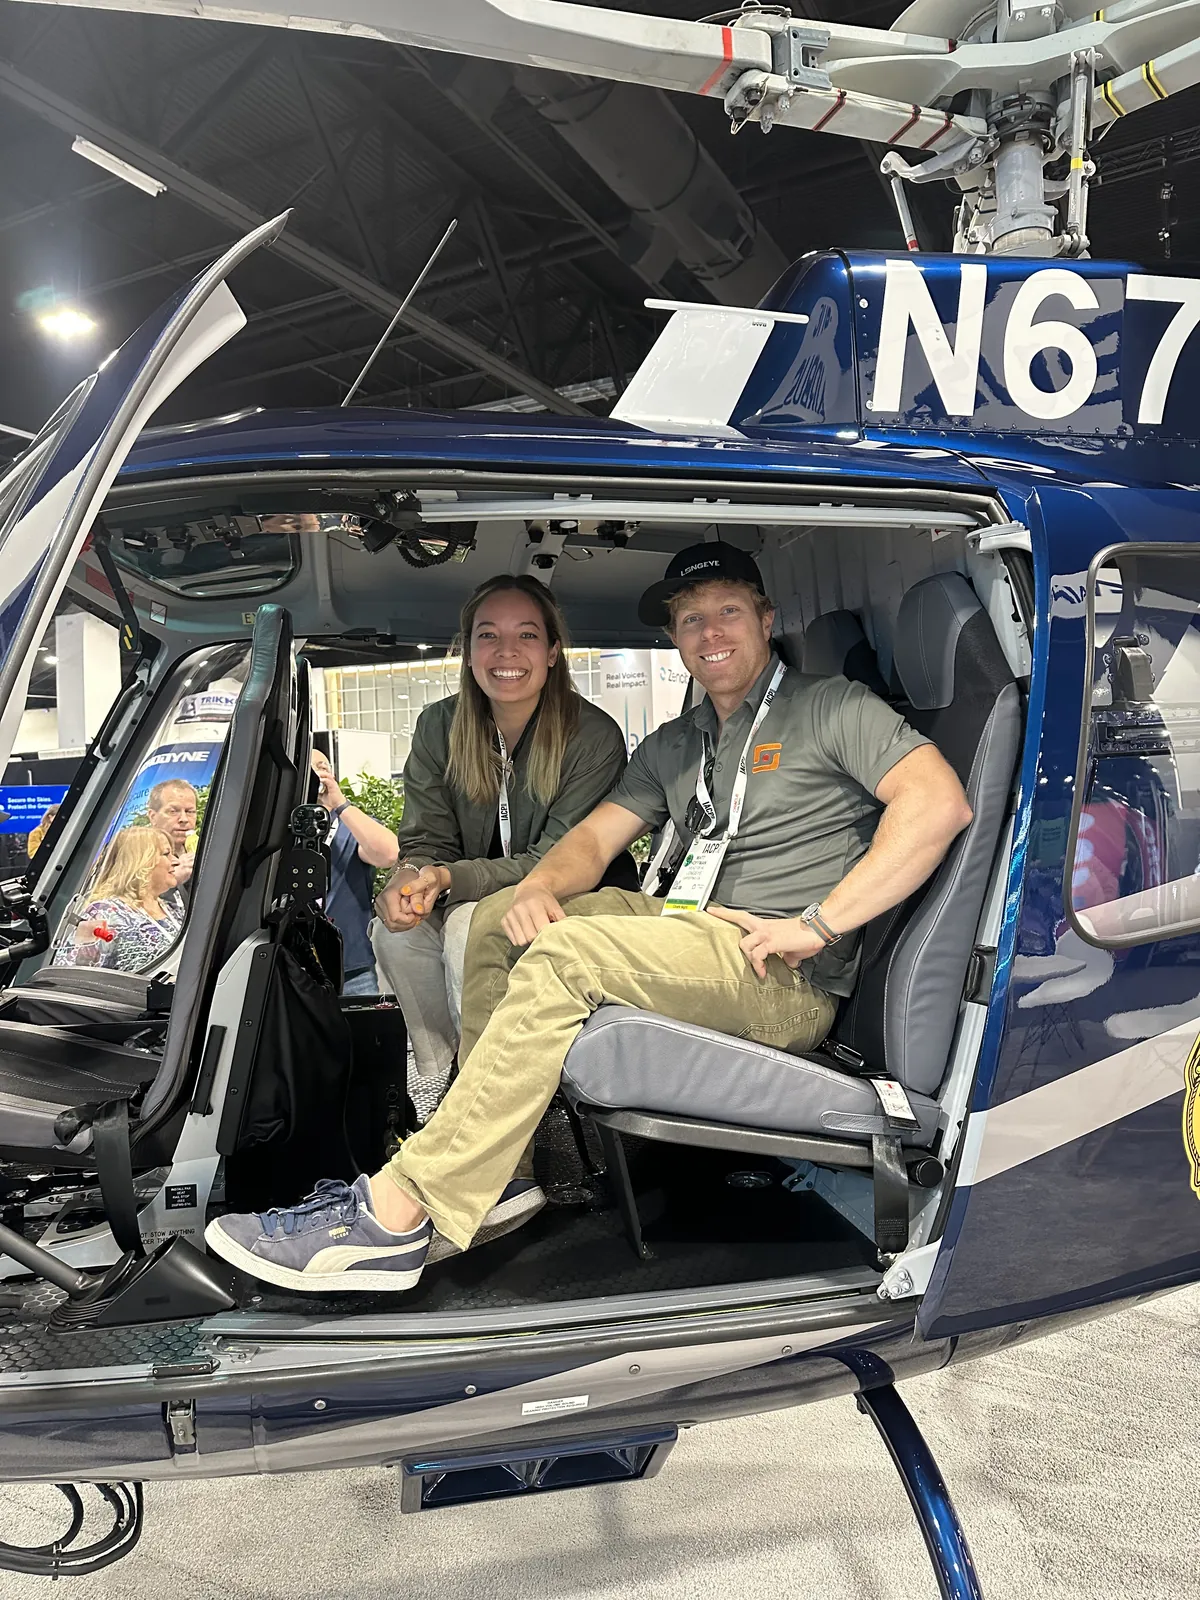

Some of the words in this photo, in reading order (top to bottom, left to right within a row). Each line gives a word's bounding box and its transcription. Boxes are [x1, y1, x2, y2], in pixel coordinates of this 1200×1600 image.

[606, 673, 620, 681] Real
[622, 671, 648, 680] Voices.
[622, 680, 648, 689] Impact.
[151, 1230, 166, 1238] STOW
[168, 1228, 195, 1236] ANYTHING
